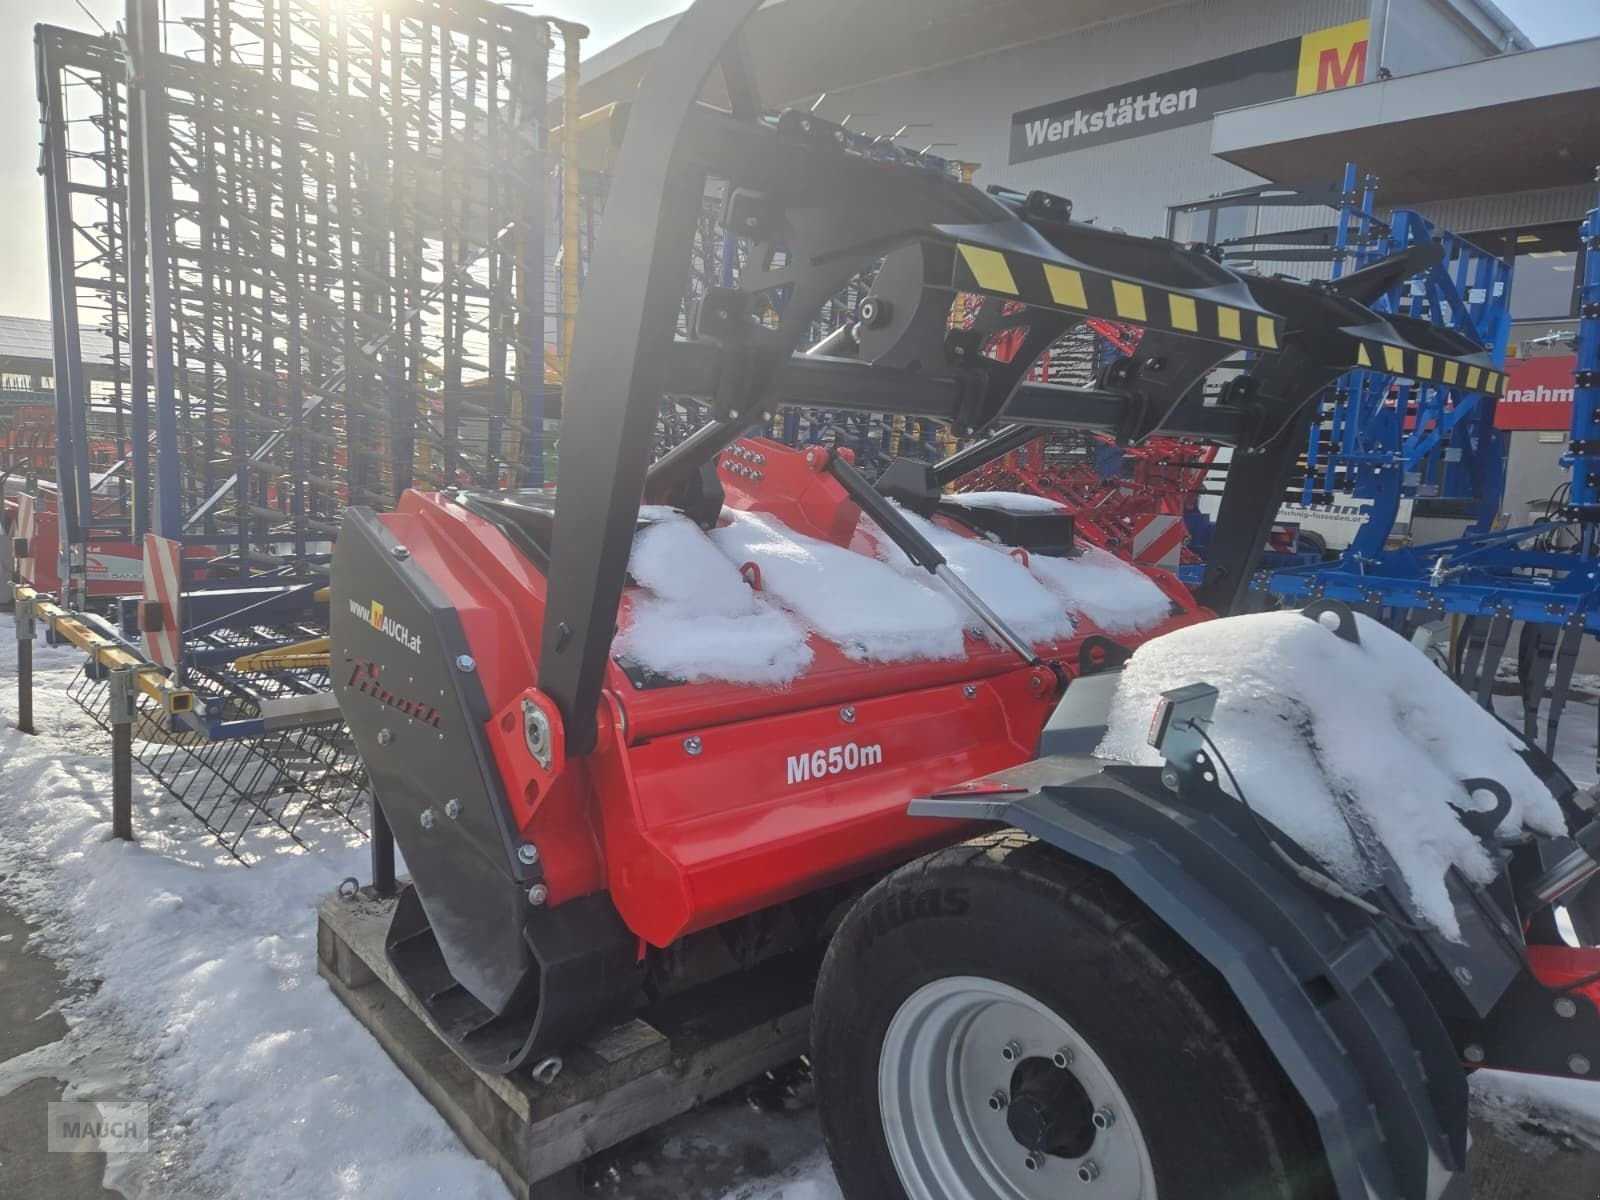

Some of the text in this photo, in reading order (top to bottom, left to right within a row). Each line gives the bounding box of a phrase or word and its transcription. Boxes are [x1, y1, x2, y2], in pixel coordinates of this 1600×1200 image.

[1316, 39, 1369, 92] M
[1024, 86, 1199, 147] Werkstätten
[1499, 385, 1575, 403] nahm
[349, 599, 422, 654] www.MAUCH.at
[786, 742, 883, 785] M650m
